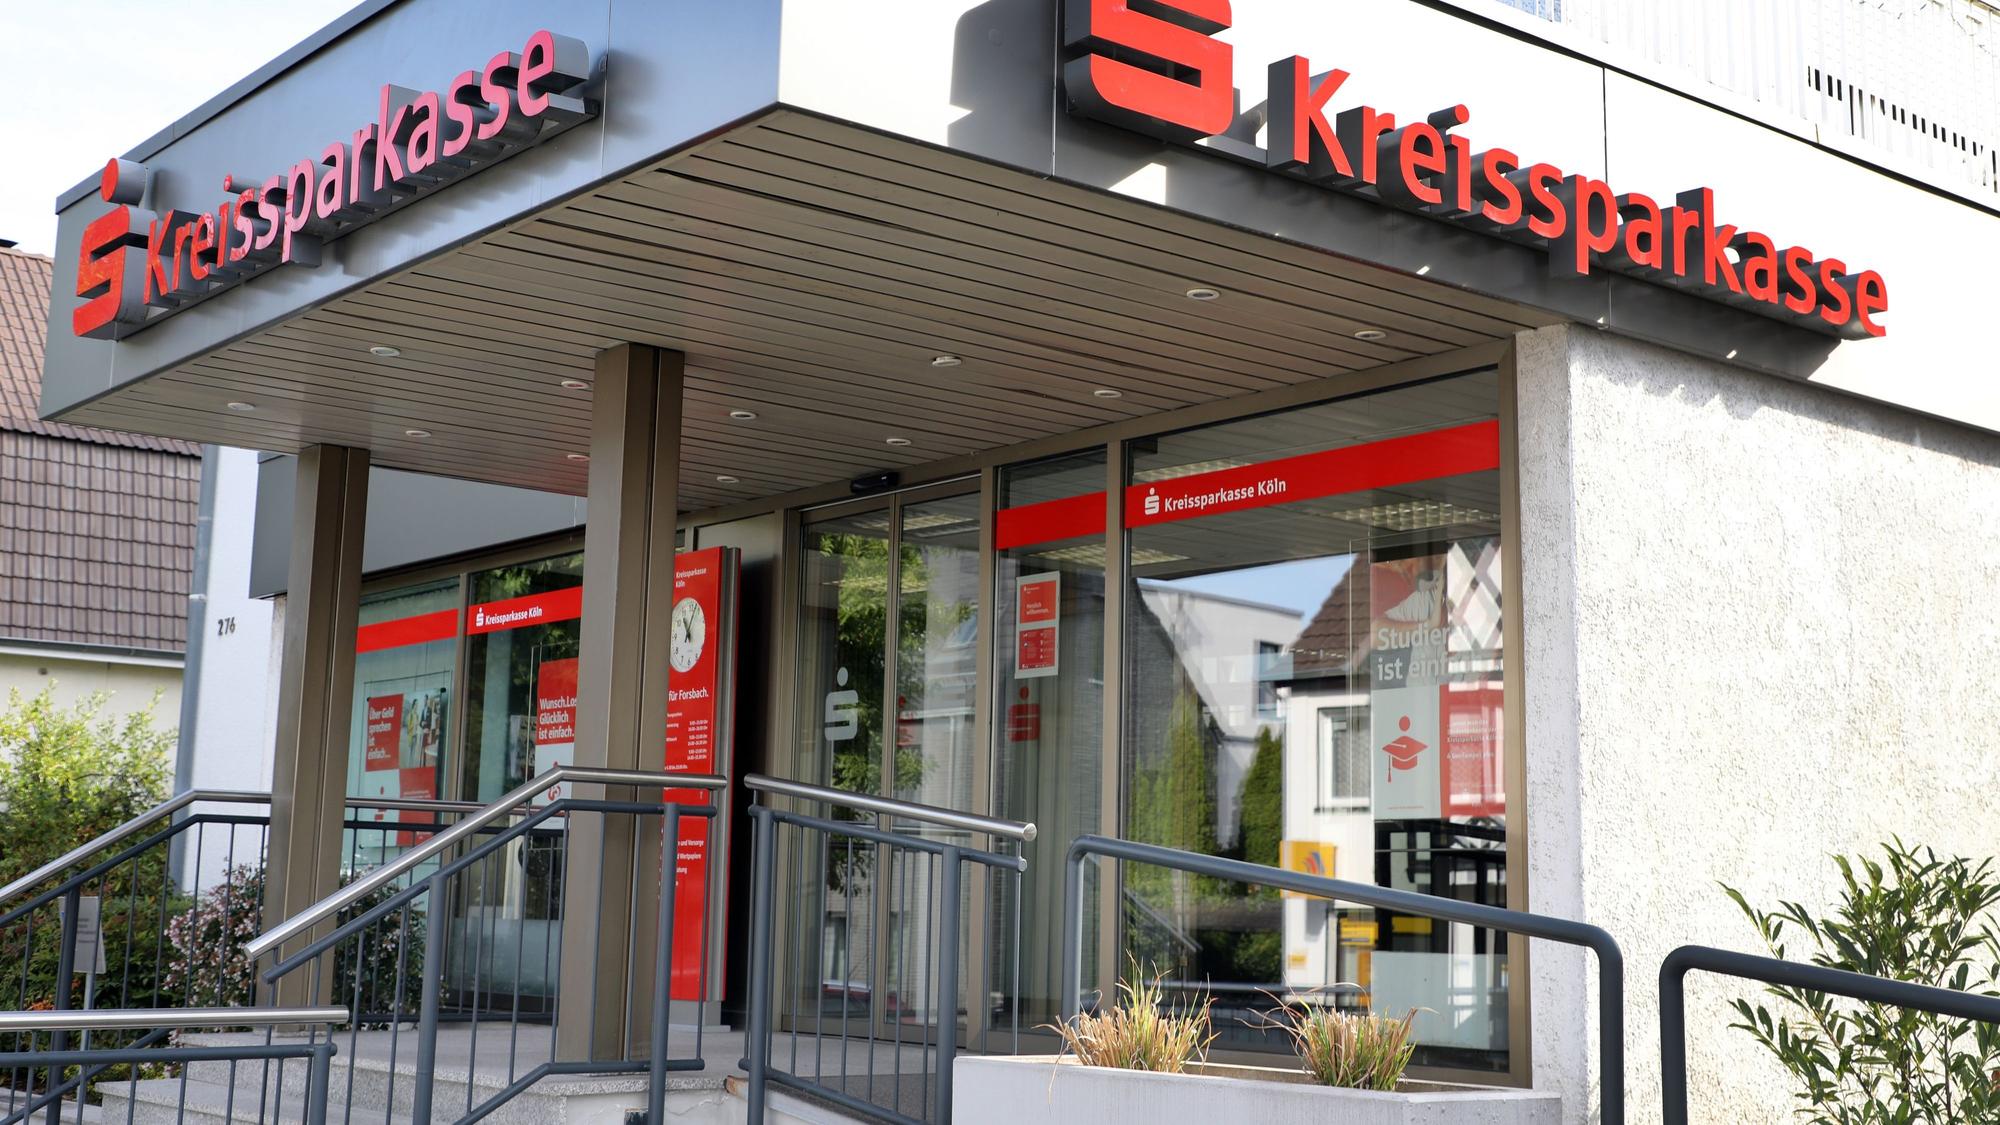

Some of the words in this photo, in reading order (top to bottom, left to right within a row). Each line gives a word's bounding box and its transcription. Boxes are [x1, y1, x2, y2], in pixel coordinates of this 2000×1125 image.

[143, 30, 556, 305] Kreissparkasse
[1293, 54, 1889, 338] Kreissparkasse
[1164, 486, 1255, 512] Kreissparkasse
[1257, 478, 1287, 496] Köln
[485, 610, 528, 625] Kreissparkasse
[529, 606, 543, 618] Köln
[218, 616, 236, 636] 276
[1378, 657, 1404, 681] ist
[678, 687, 709, 700] Forsbach.
[540, 710, 569, 725] Glücklich
[539, 727, 547, 739] ist
[549, 725, 574, 739] einfach.
